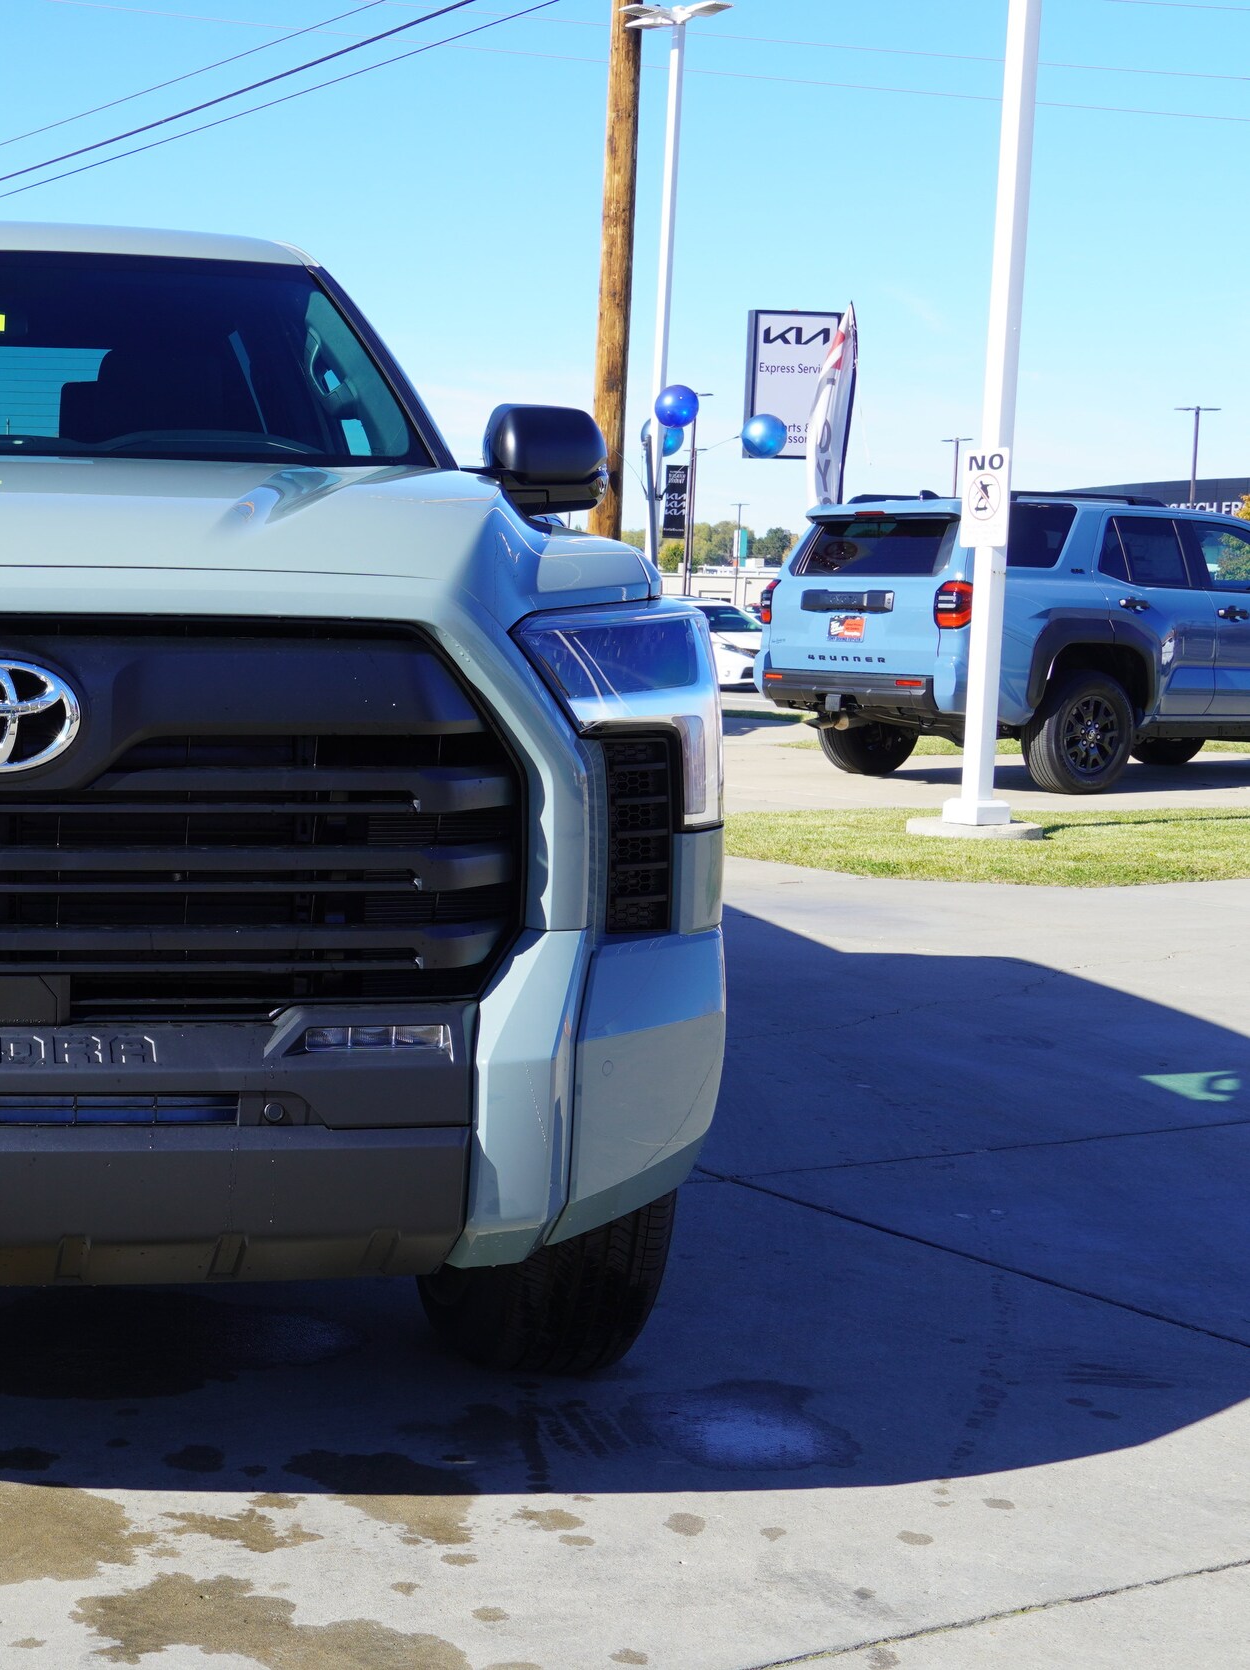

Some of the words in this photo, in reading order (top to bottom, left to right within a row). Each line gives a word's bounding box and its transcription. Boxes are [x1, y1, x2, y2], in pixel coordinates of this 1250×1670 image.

[763, 326, 830, 345] KIA
[759, 362, 795, 375] Express
[797, 363, 823, 374] Servi
[968, 453, 1005, 472] NO
[807, 654, 886, 663] 4RUNNER
